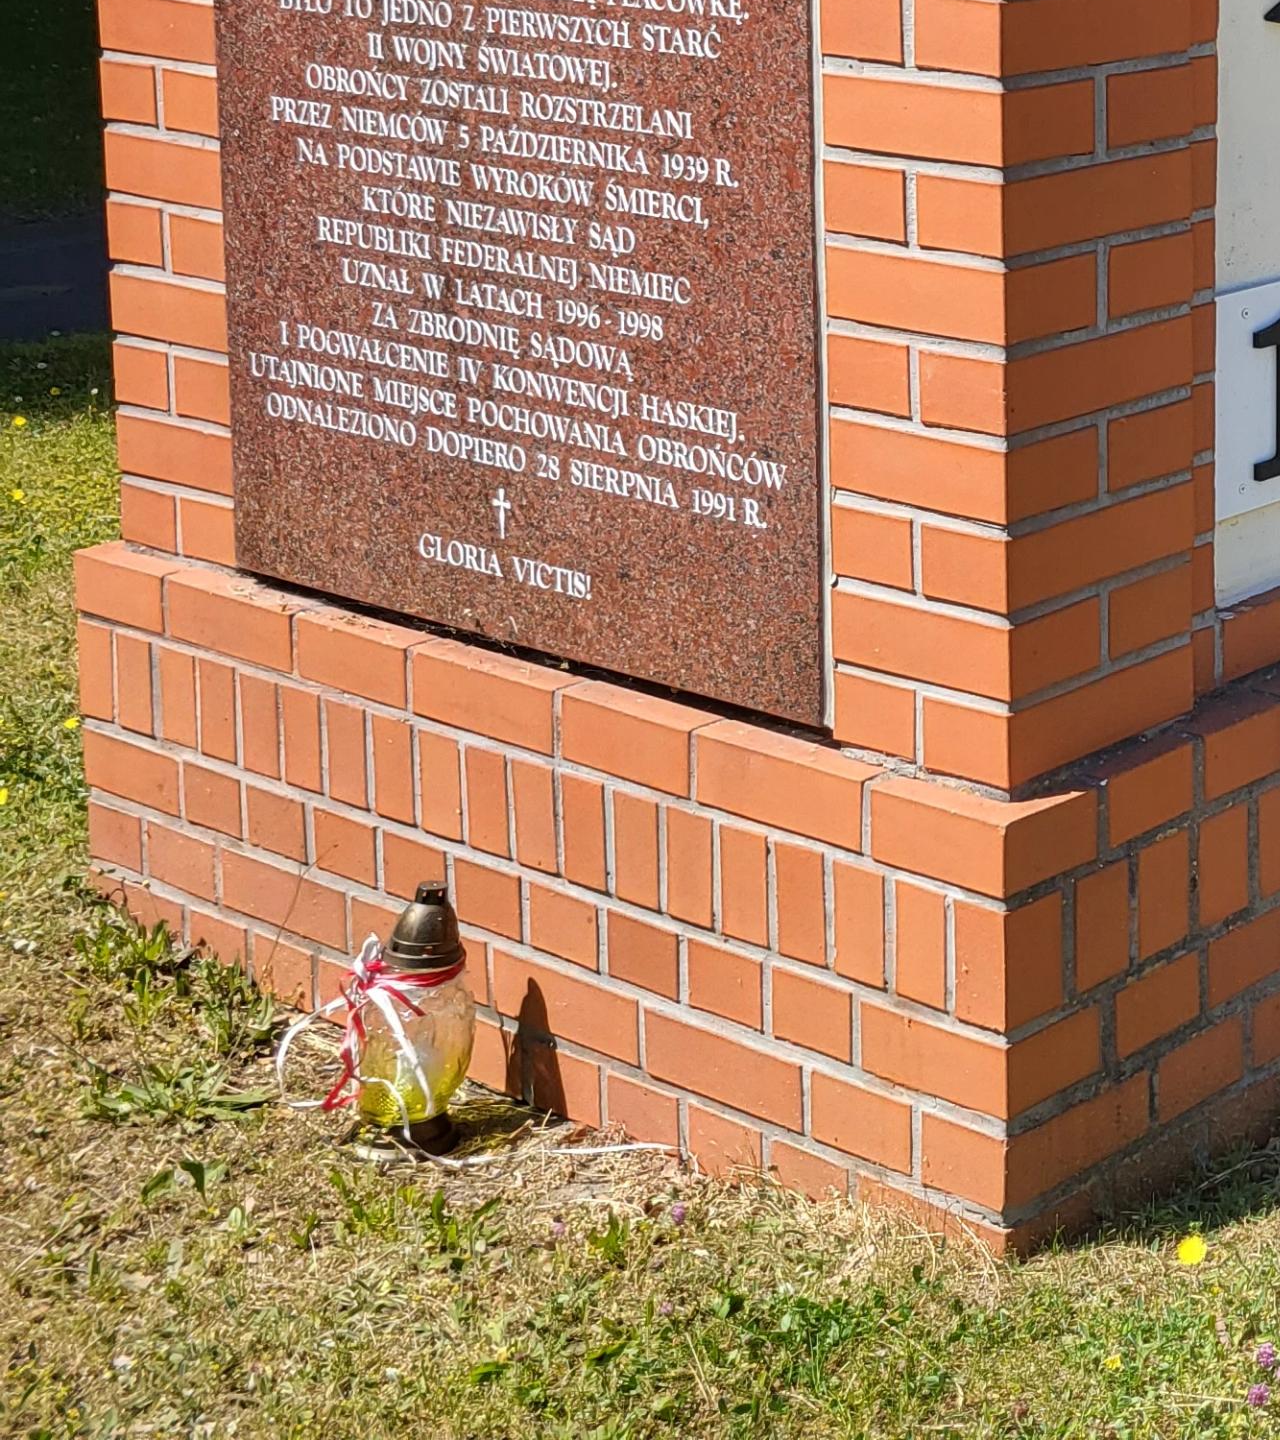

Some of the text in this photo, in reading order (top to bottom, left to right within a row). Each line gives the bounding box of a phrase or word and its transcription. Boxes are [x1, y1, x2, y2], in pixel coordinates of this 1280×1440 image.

[368, 33, 618, 92] II WOJNY ŚWIATOWEJ.
[463, 5, 475, 31] Z
[485, 7, 631, 49] PIERWSZYCH
[641, 24, 721, 59] STARĆ
[272, 96, 739, 188] PRZEZ NIEMCÓW 5 PAŹDZIERNIKA 1939 R.
[306, 64, 692, 139] OBROŃCY ZOSTALI ROZSTRZELANI
[297, 138, 709, 229] NA PODSTAWIE WYROKÓW ŚMIERCI,
[362, 185, 636, 258] KTÓRE NIEZAWISŁY SĄD
[318, 216, 691, 305] REPUBLIKI FEDERALNEJ NIEMIEC
[342, 258, 414, 295] UZNAŁ
[424, 272, 444, 300] W
[455, 278, 543, 320] LATACH
[556, 300, 600, 330] 1996
[618, 310, 663, 342] 1998
[280, 321, 745, 444] I POGWAŁCENIE IV KONWENCJI HASKIEJ.
[372, 301, 633, 383] ZA ZBRODNIĘ SĄDOWĄ
[249, 352, 786, 491] UTAJNIONE MIEJSCE POCHOWANIA OBROŃCÓW
[267, 392, 767, 529] ODNALEZIONO DOPIERO 28 SIERPNIA 1991 R.
[419, 533, 591, 600] GLORIA VICTIS!
